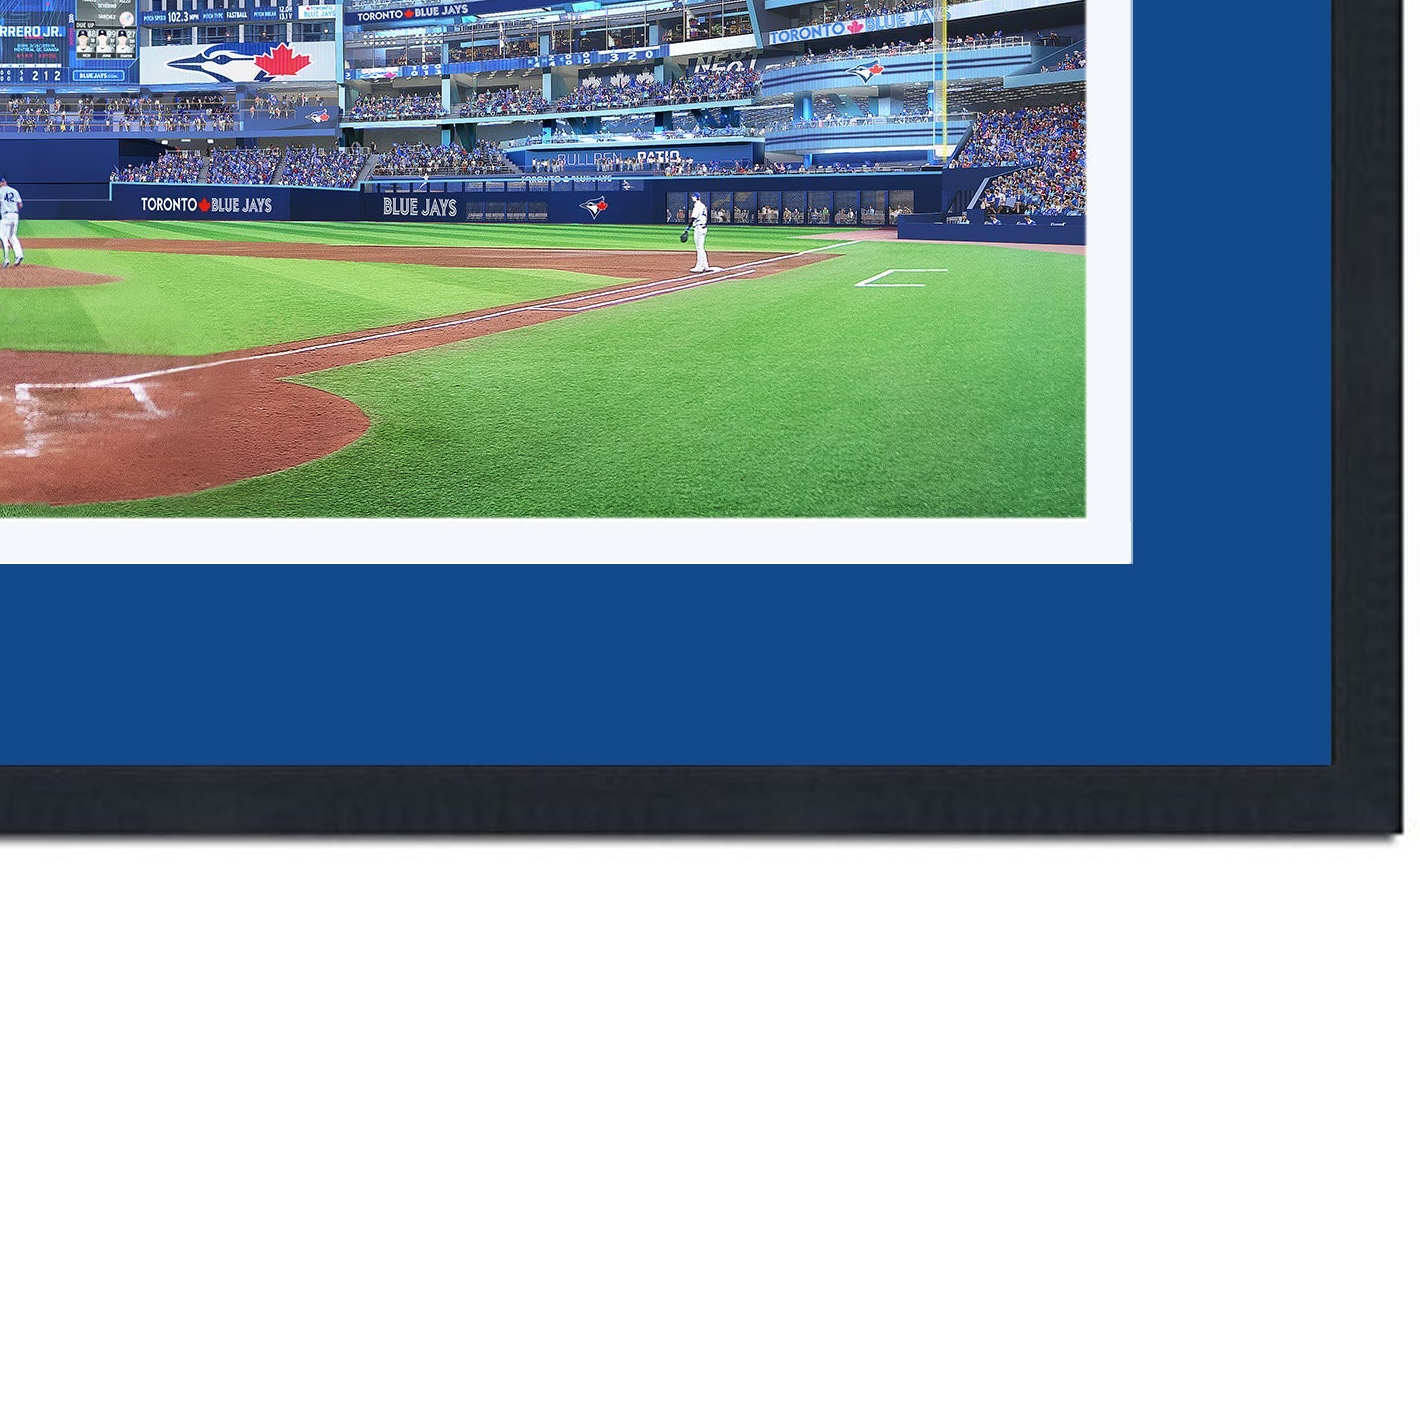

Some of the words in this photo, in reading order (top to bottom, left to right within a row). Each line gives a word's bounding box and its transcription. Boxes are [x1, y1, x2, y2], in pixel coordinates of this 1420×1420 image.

[168, 12, 189, 22] 102.3
[358, 10, 403, 21] TORONTO
[415, 7, 439, 17] BLUE
[442, 4, 468, 15] JAYS
[43, 26, 62, 37] JR.
[770, 21, 846, 44] TORONTO
[865, 13, 906, 31] BLUE
[610, 54, 619, 62] 3
[628, 52, 637, 60] 2
[32, 71, 38, 80] 2
[44, 71, 48, 80] 1
[54, 71, 60, 80] 2
[4, 192, 14, 202] 42
[141, 197, 198, 211] TORONTO
[211, 197, 240, 212] BLUE
[242, 197, 272, 213] JAYS
[383, 198, 418, 216] BLUE
[421, 198, 457, 217] JAYS
